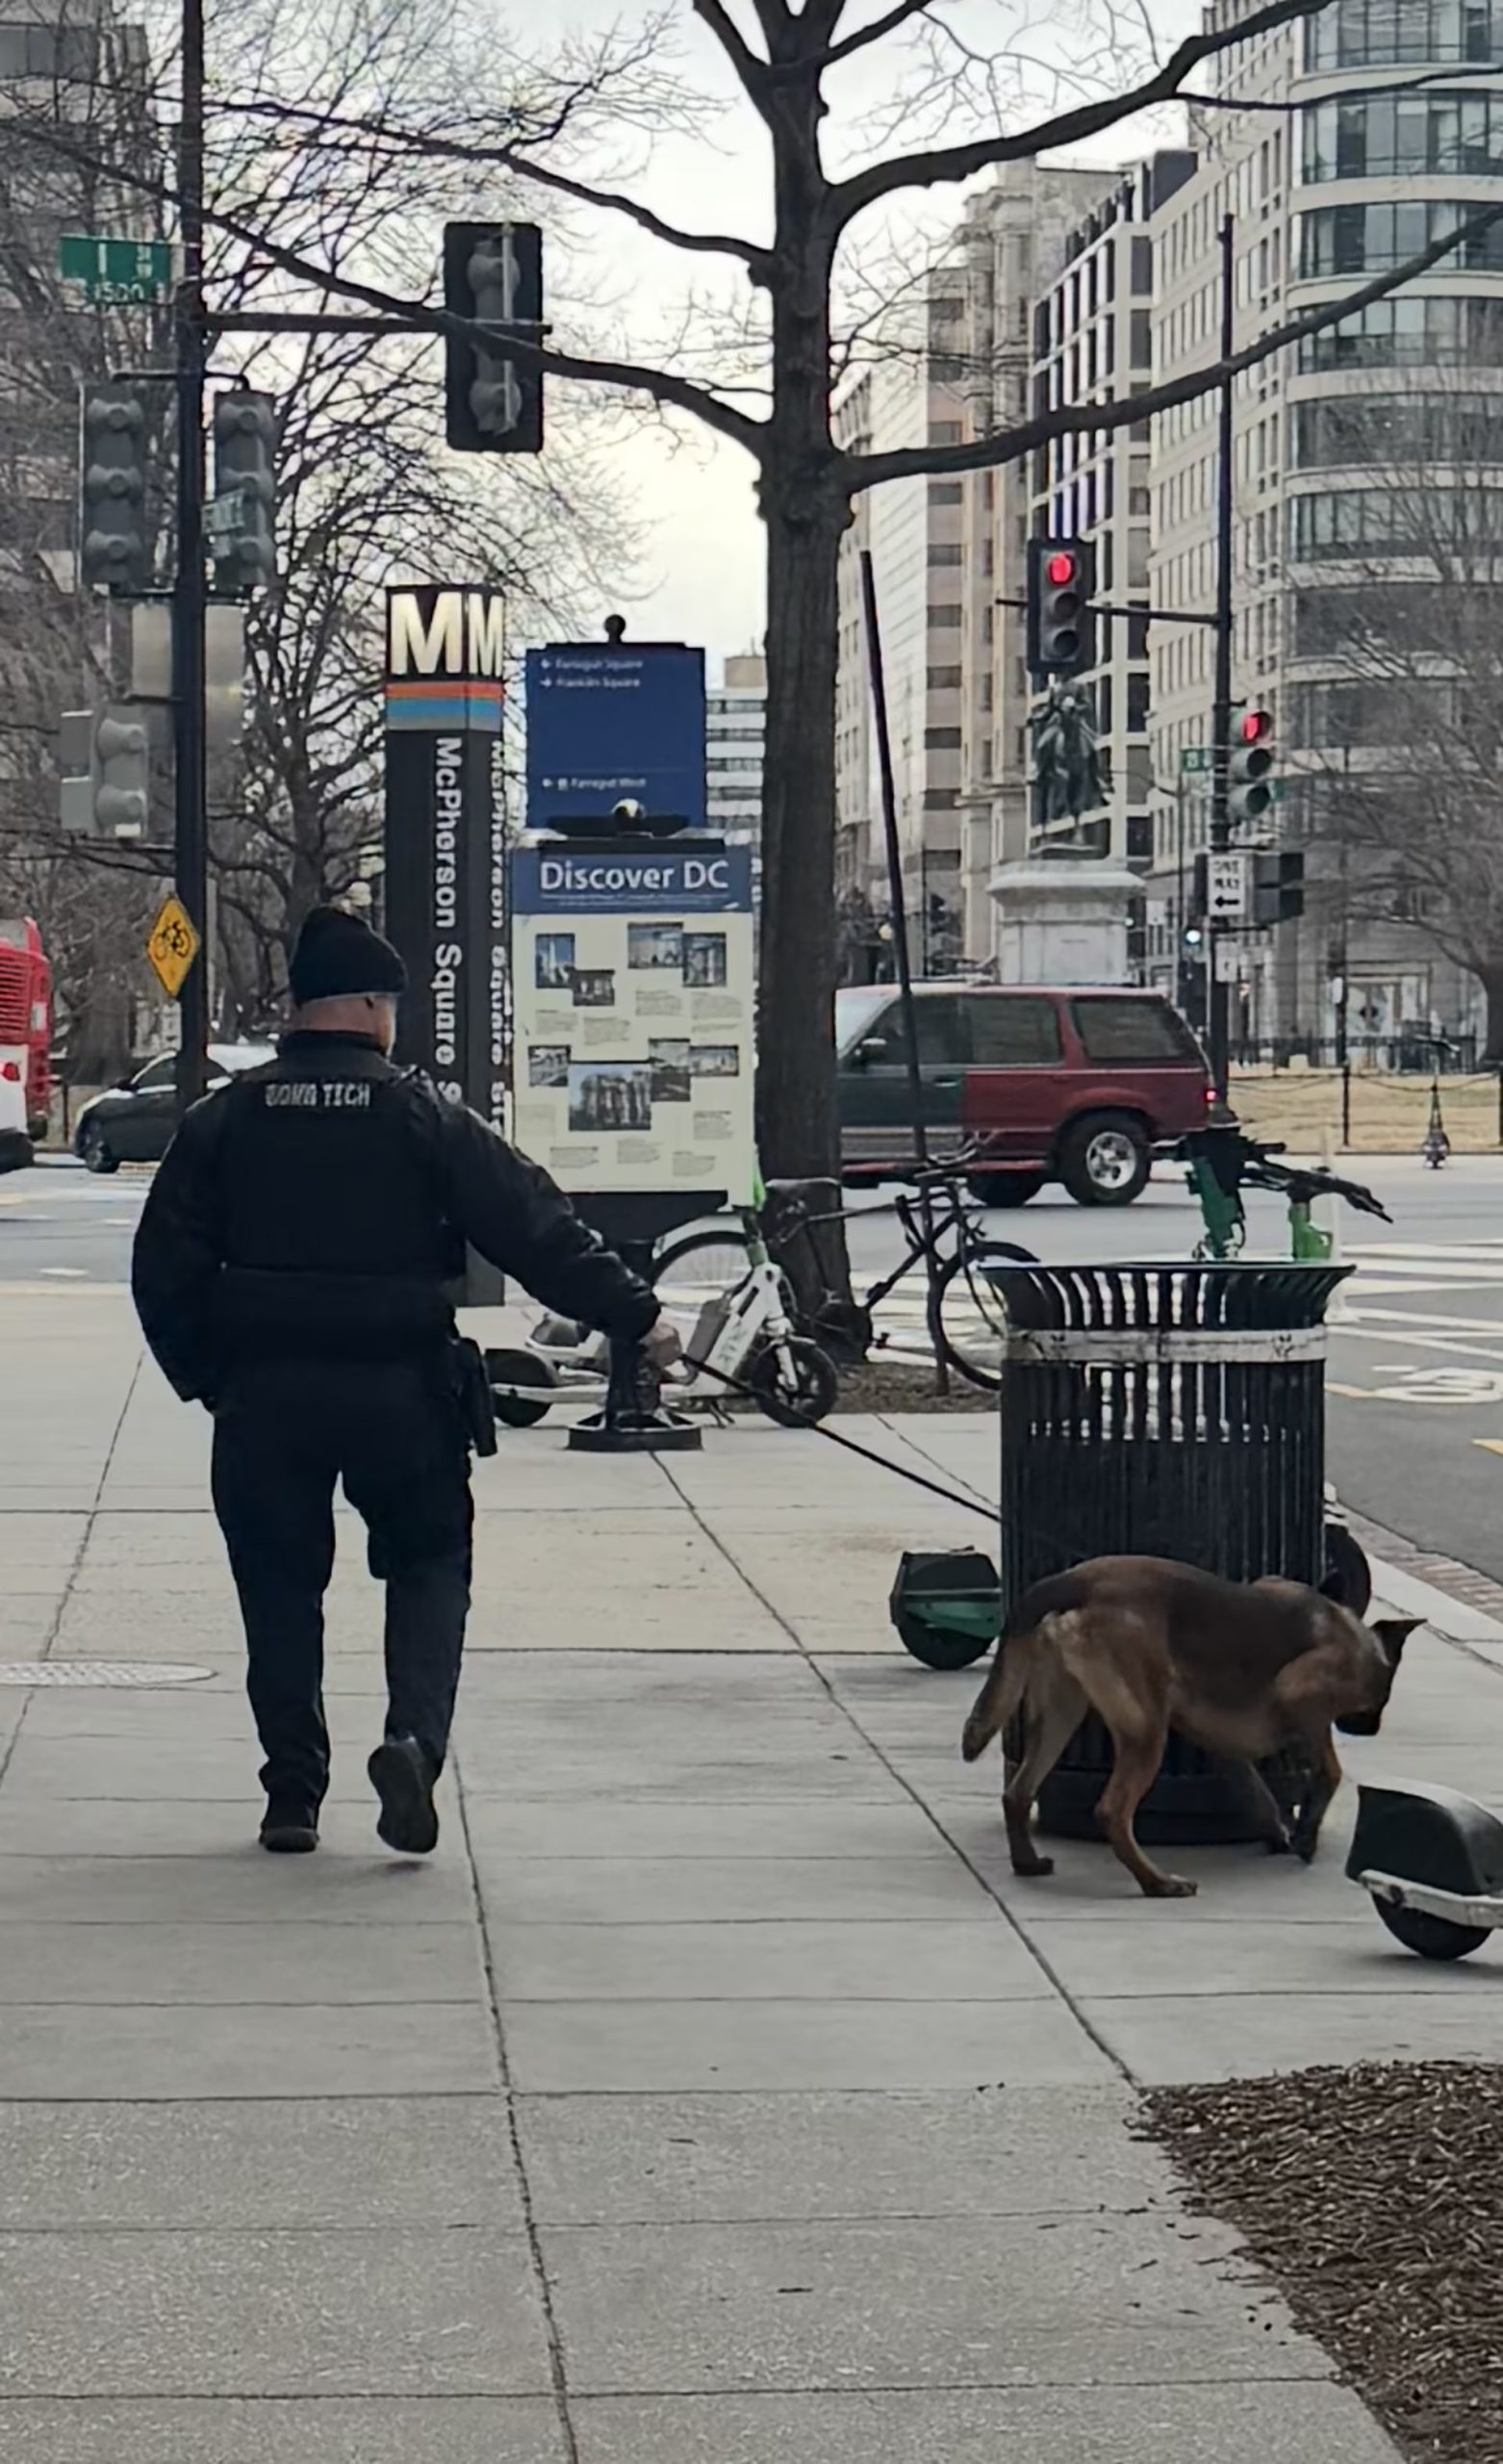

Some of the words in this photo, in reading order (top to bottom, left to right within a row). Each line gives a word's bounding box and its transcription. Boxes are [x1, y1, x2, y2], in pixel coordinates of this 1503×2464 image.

[391, 592, 462, 675] M
[469, 593, 503, 678] M
[436, 737, 462, 928] McPherson
[540, 860, 674, 890] Discover
[683, 860, 729, 889] DC
[430, 944, 462, 1065] Square
